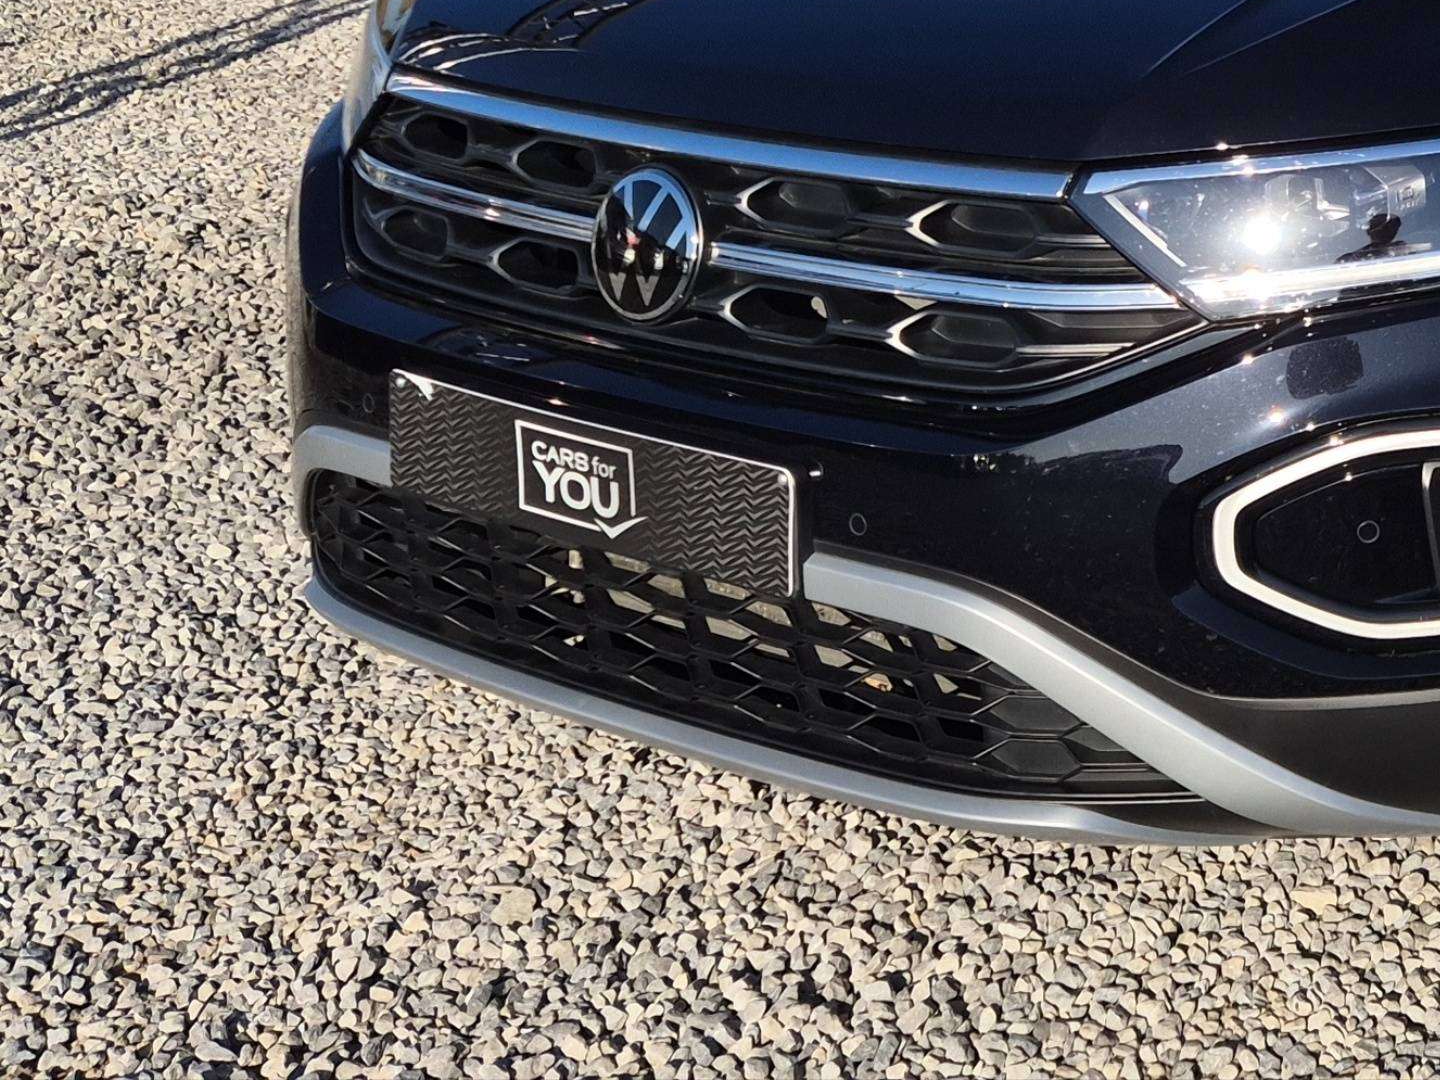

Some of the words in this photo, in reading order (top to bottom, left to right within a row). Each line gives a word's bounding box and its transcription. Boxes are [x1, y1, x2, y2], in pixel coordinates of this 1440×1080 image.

[531, 440, 590, 473] CARS
[591, 456, 617, 479] for
[531, 460, 620, 519] YOU
